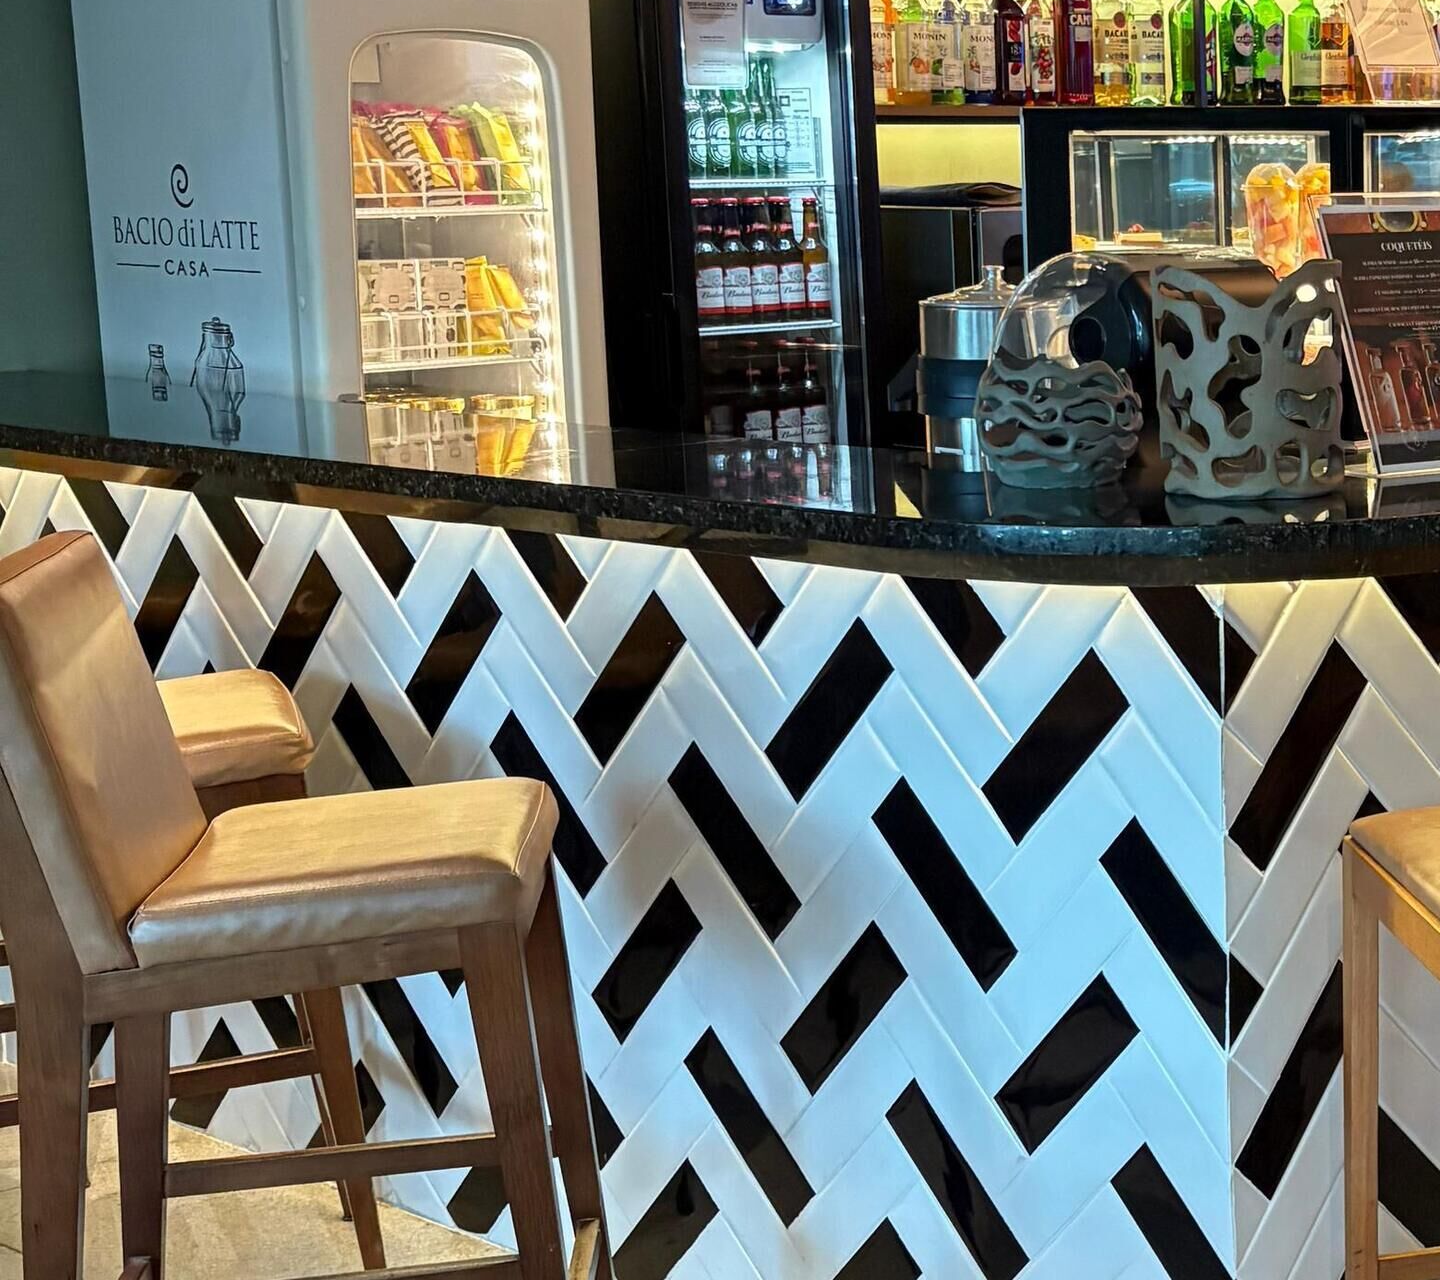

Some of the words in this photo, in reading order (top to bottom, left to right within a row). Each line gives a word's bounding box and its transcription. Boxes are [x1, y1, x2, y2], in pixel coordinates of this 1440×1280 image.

[913, 31, 947, 42] MONIN
[113, 216, 174, 247] BACIO
[177, 219, 195, 248] di
[200, 219, 260, 251] LATTE
[1380, 238, 1433, 253] COQUETÉIS
[164, 259, 210, 278] CASA
